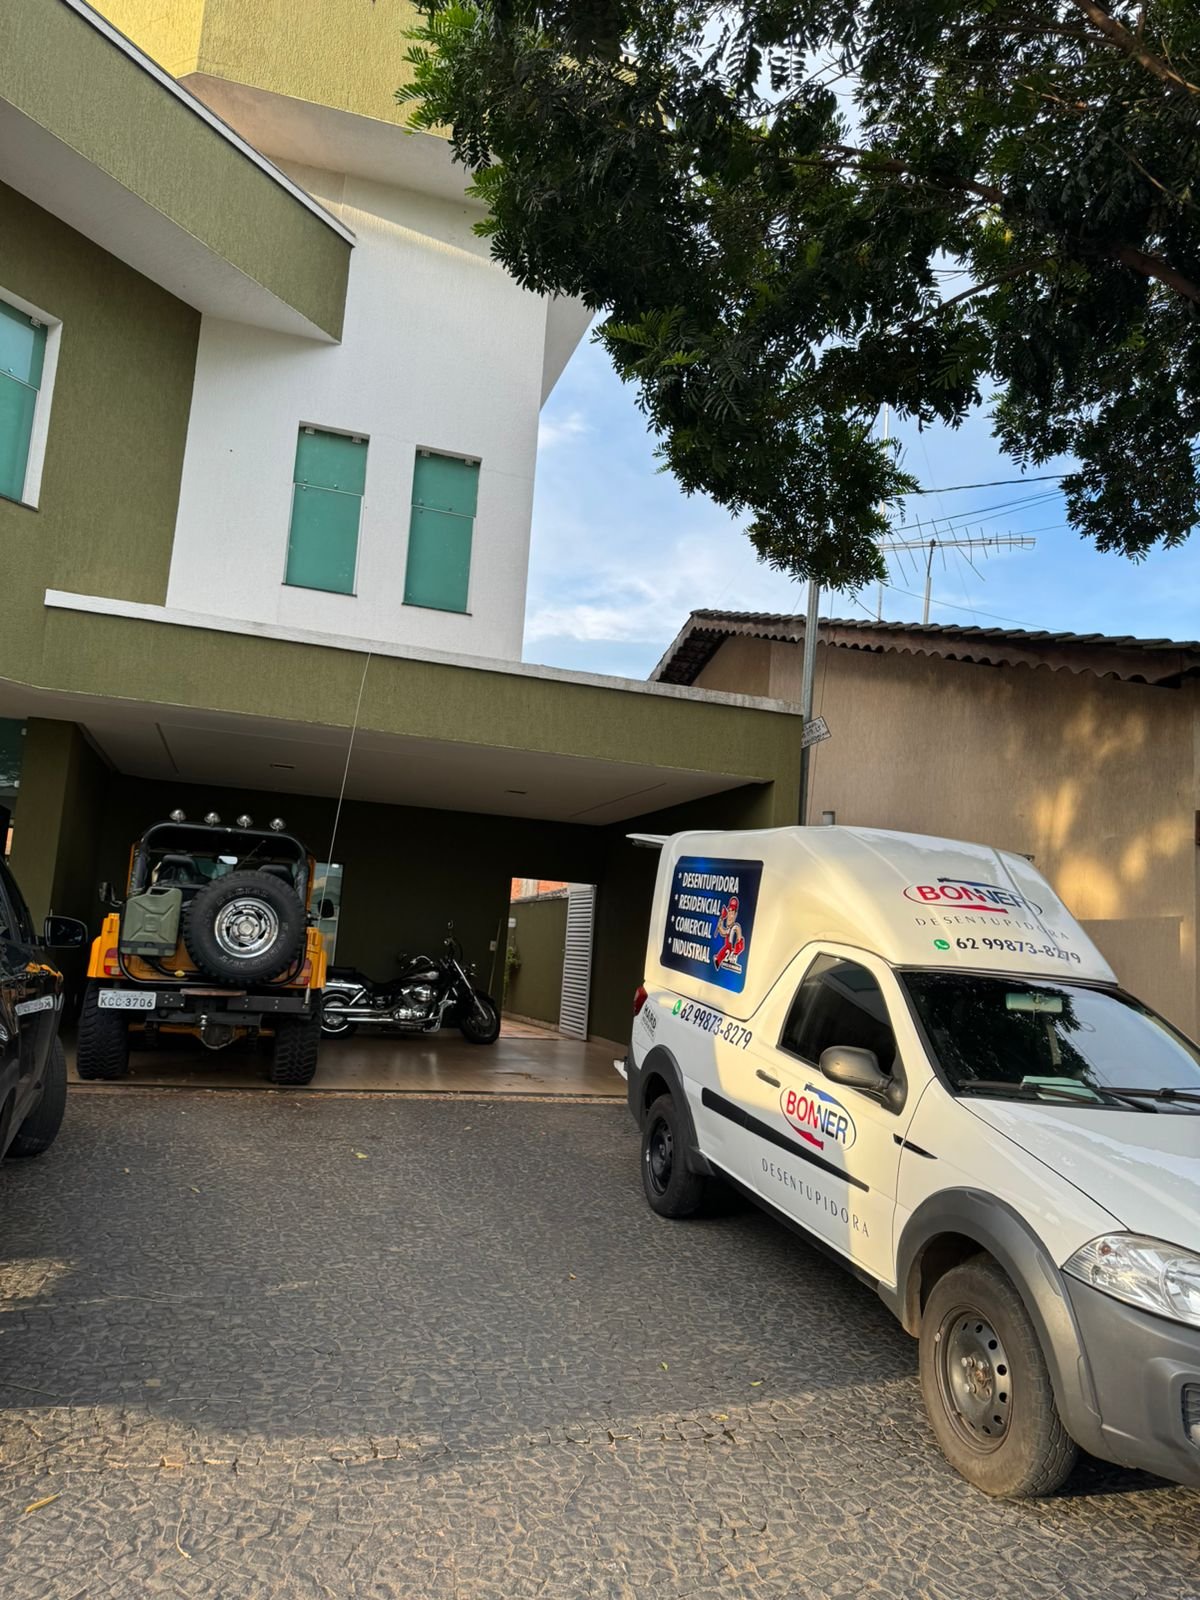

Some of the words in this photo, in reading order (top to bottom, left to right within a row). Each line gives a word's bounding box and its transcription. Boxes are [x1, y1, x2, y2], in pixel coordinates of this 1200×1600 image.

[682, 872, 739, 894] DESENTUPIDORA
[916, 885, 1025, 908] BONNER
[678, 894, 721, 916] RESIDENCIAL
[675, 916, 712, 939] COMERCIAL
[671, 937, 711, 964] INDUSTRIAL
[956, 937, 979, 950] 62
[982, 937, 1081, 964] 99873-8279
[680, 1003, 694, 1022] 62
[692, 1008, 752, 1050] 99873-8279
[786, 1090, 849, 1144] BONNER
[762, 1158, 870, 1238] DESENTUPIDORA
